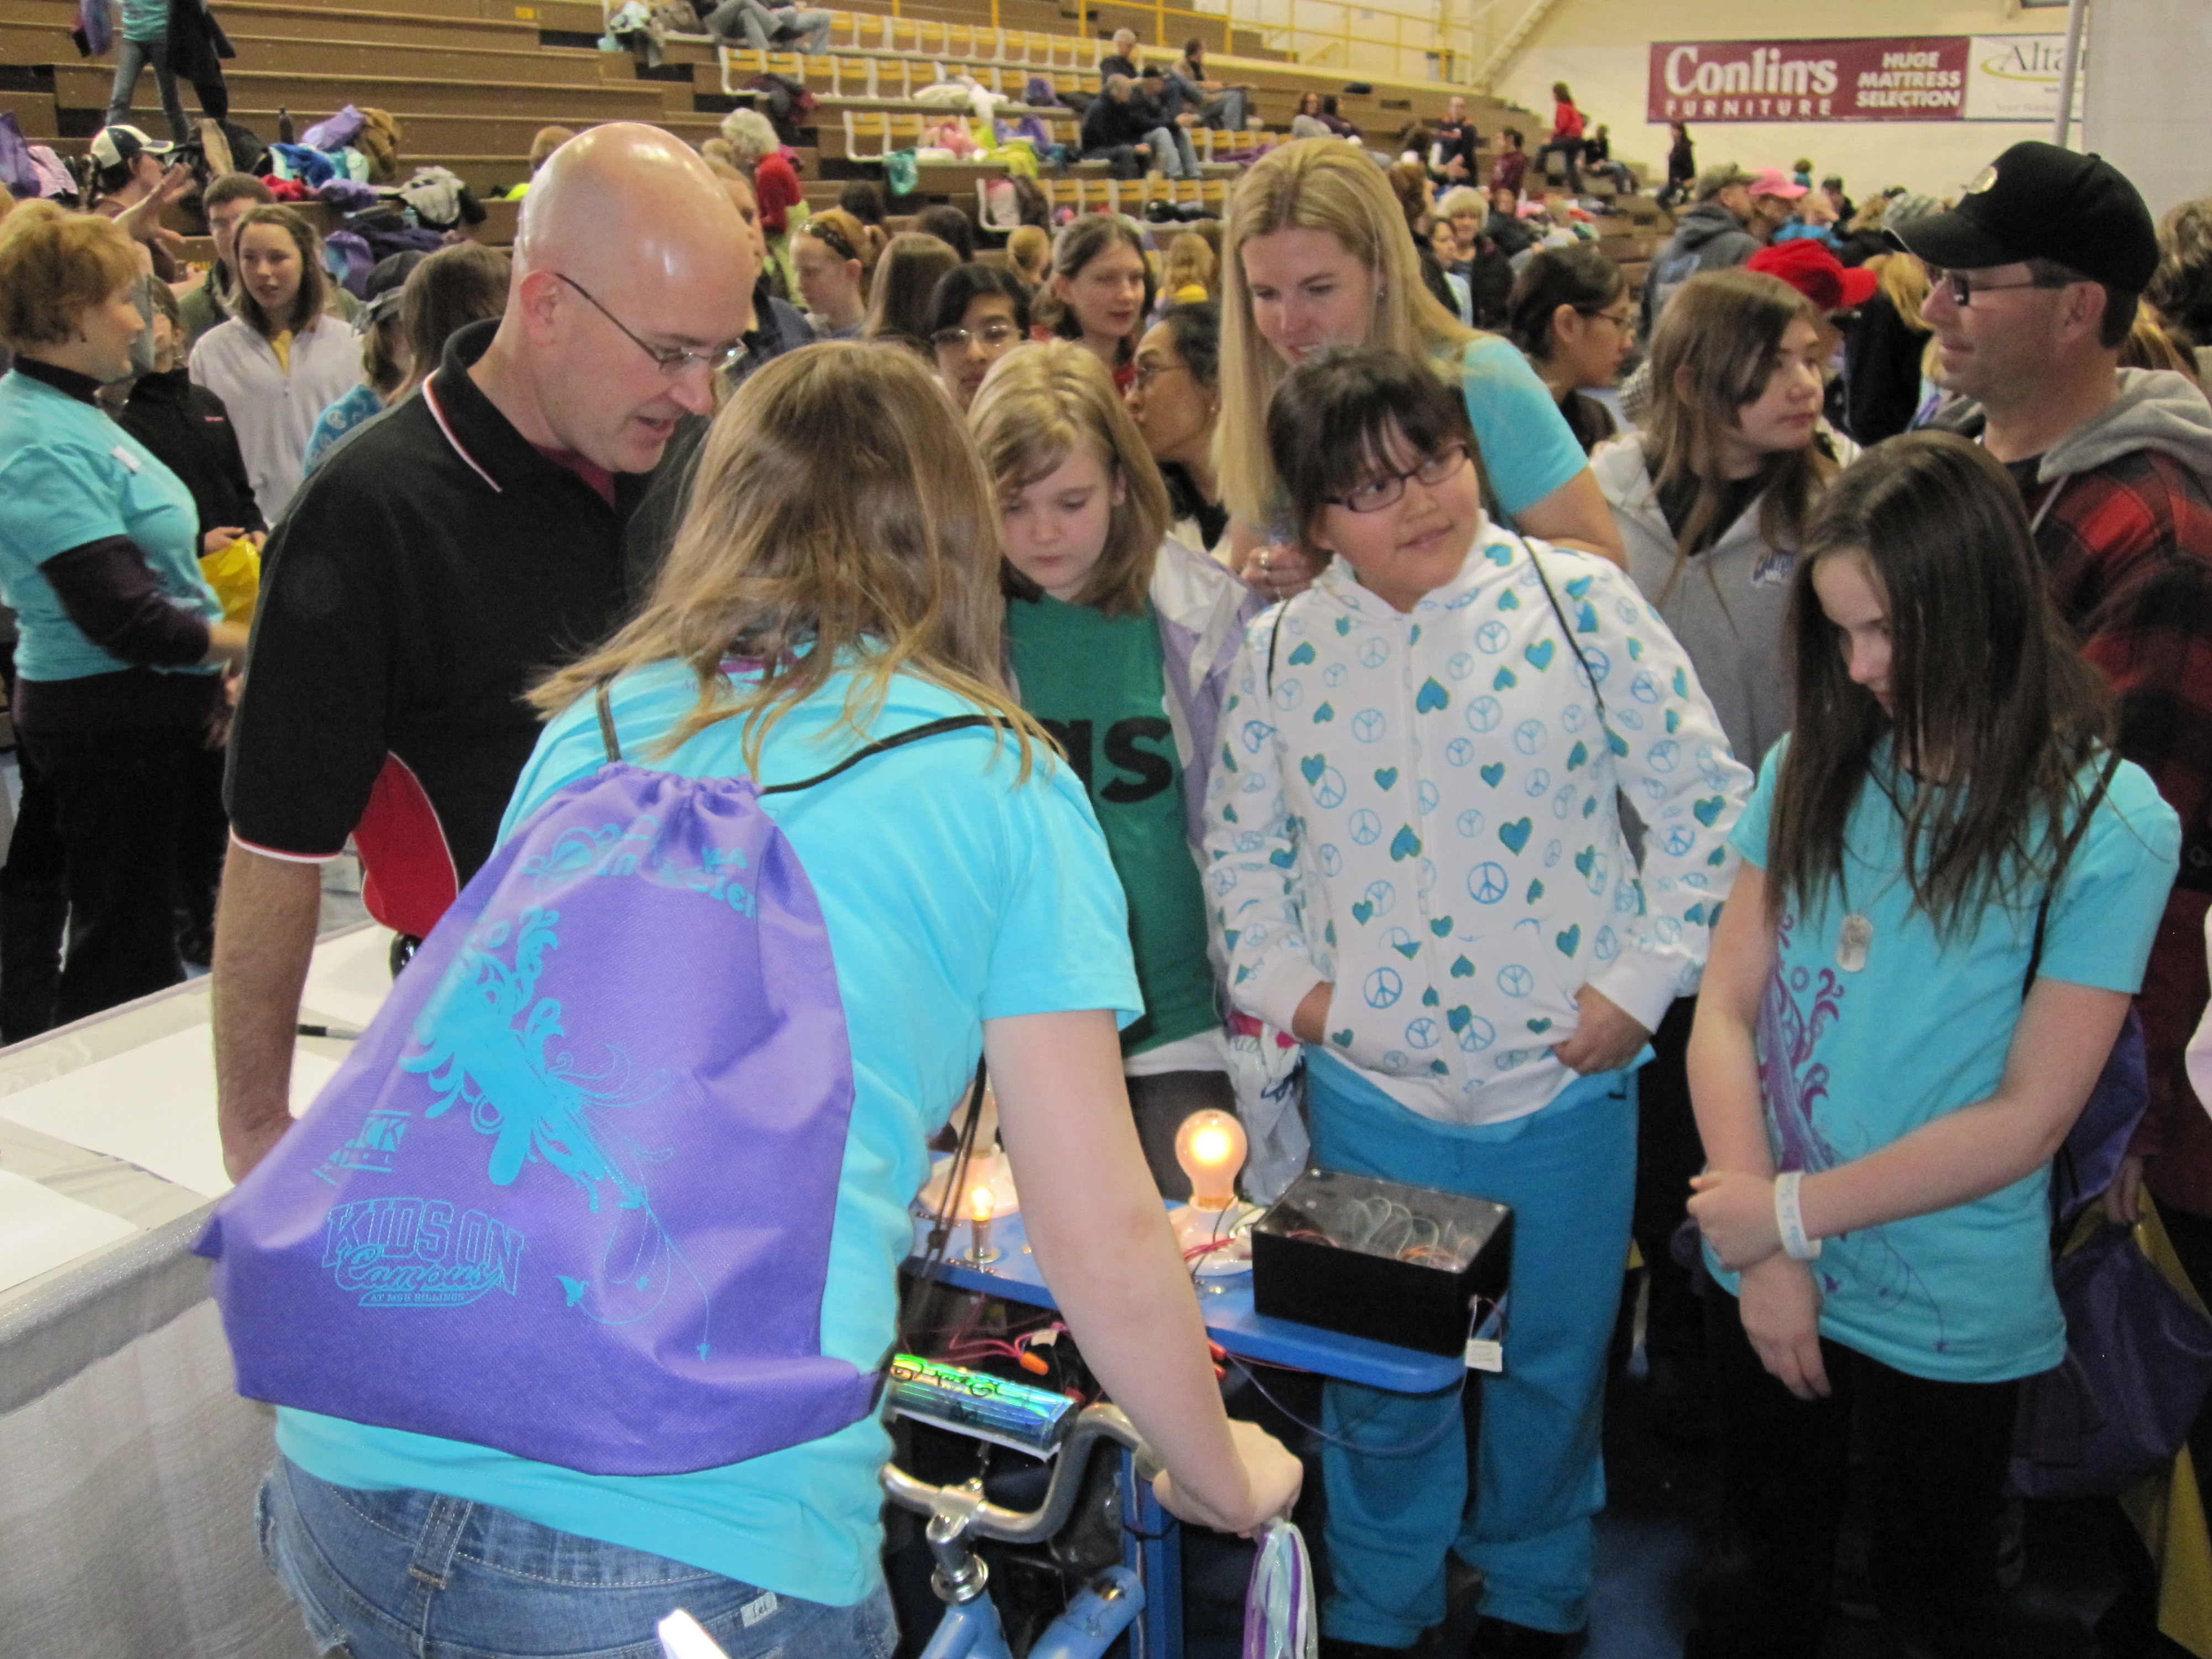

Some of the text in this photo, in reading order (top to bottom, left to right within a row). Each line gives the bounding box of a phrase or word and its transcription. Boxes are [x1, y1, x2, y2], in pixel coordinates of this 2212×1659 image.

[1881, 51, 1940, 70] HUGE
[1857, 70, 1961, 88] MATTRESS
[1665, 98, 1832, 117] FURNITURE
[1855, 89, 1961, 108] SELECTION
[335, 1243, 507, 1292] Campus
